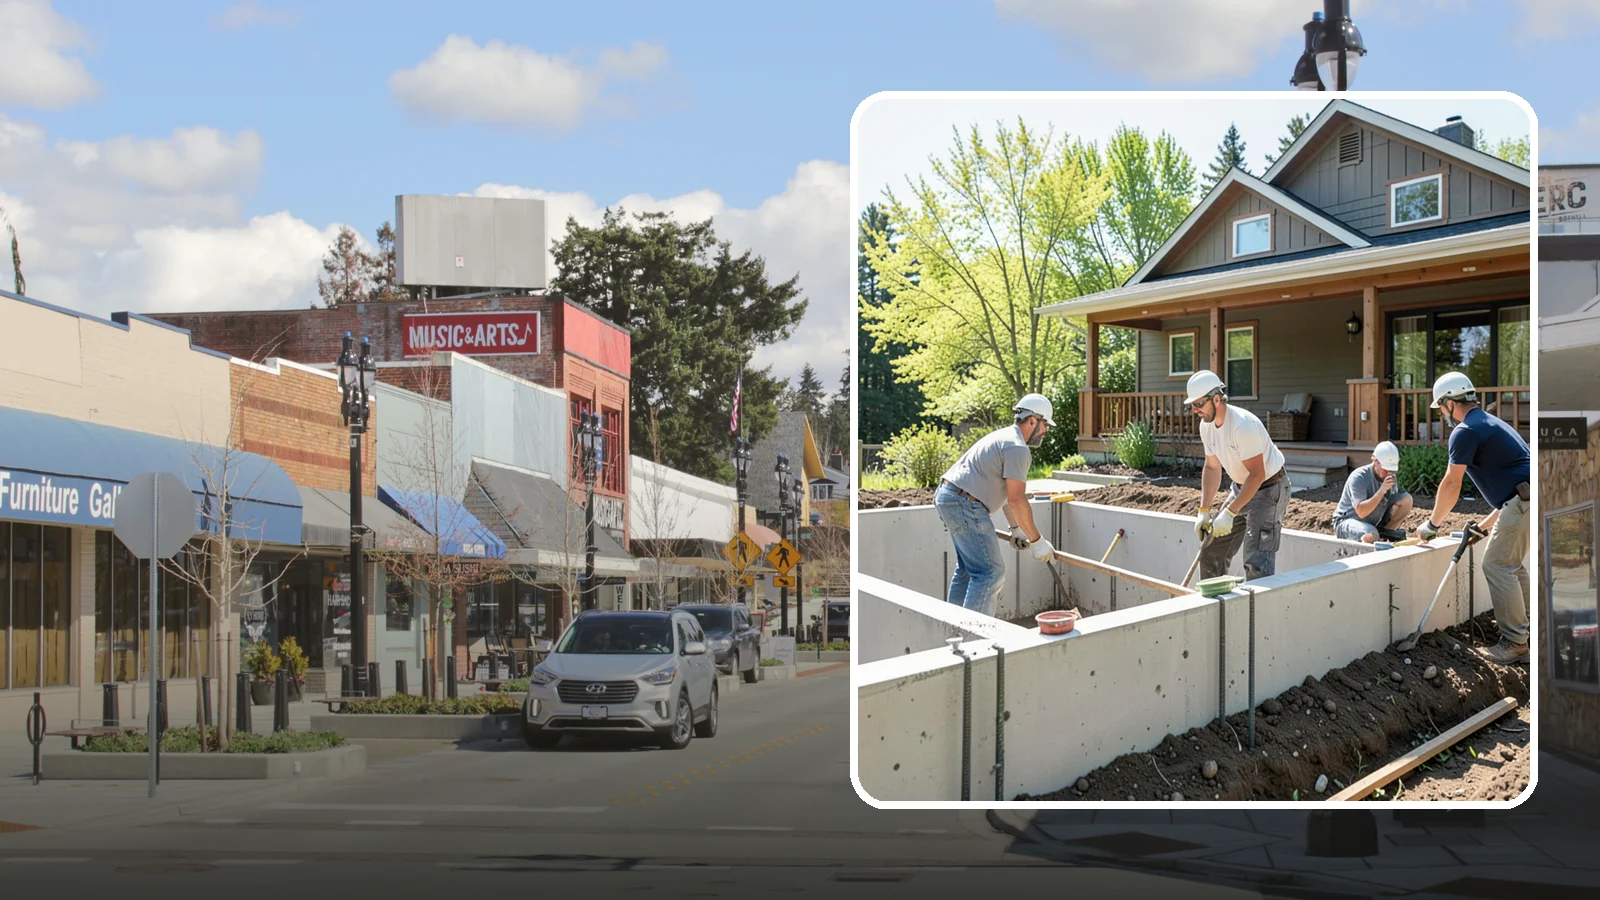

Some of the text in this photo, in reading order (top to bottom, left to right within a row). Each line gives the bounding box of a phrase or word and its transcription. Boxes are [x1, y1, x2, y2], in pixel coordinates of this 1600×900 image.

[0, 471, 121, 520] Furniture Gal
[453, 563, 480, 574] SUSHI
